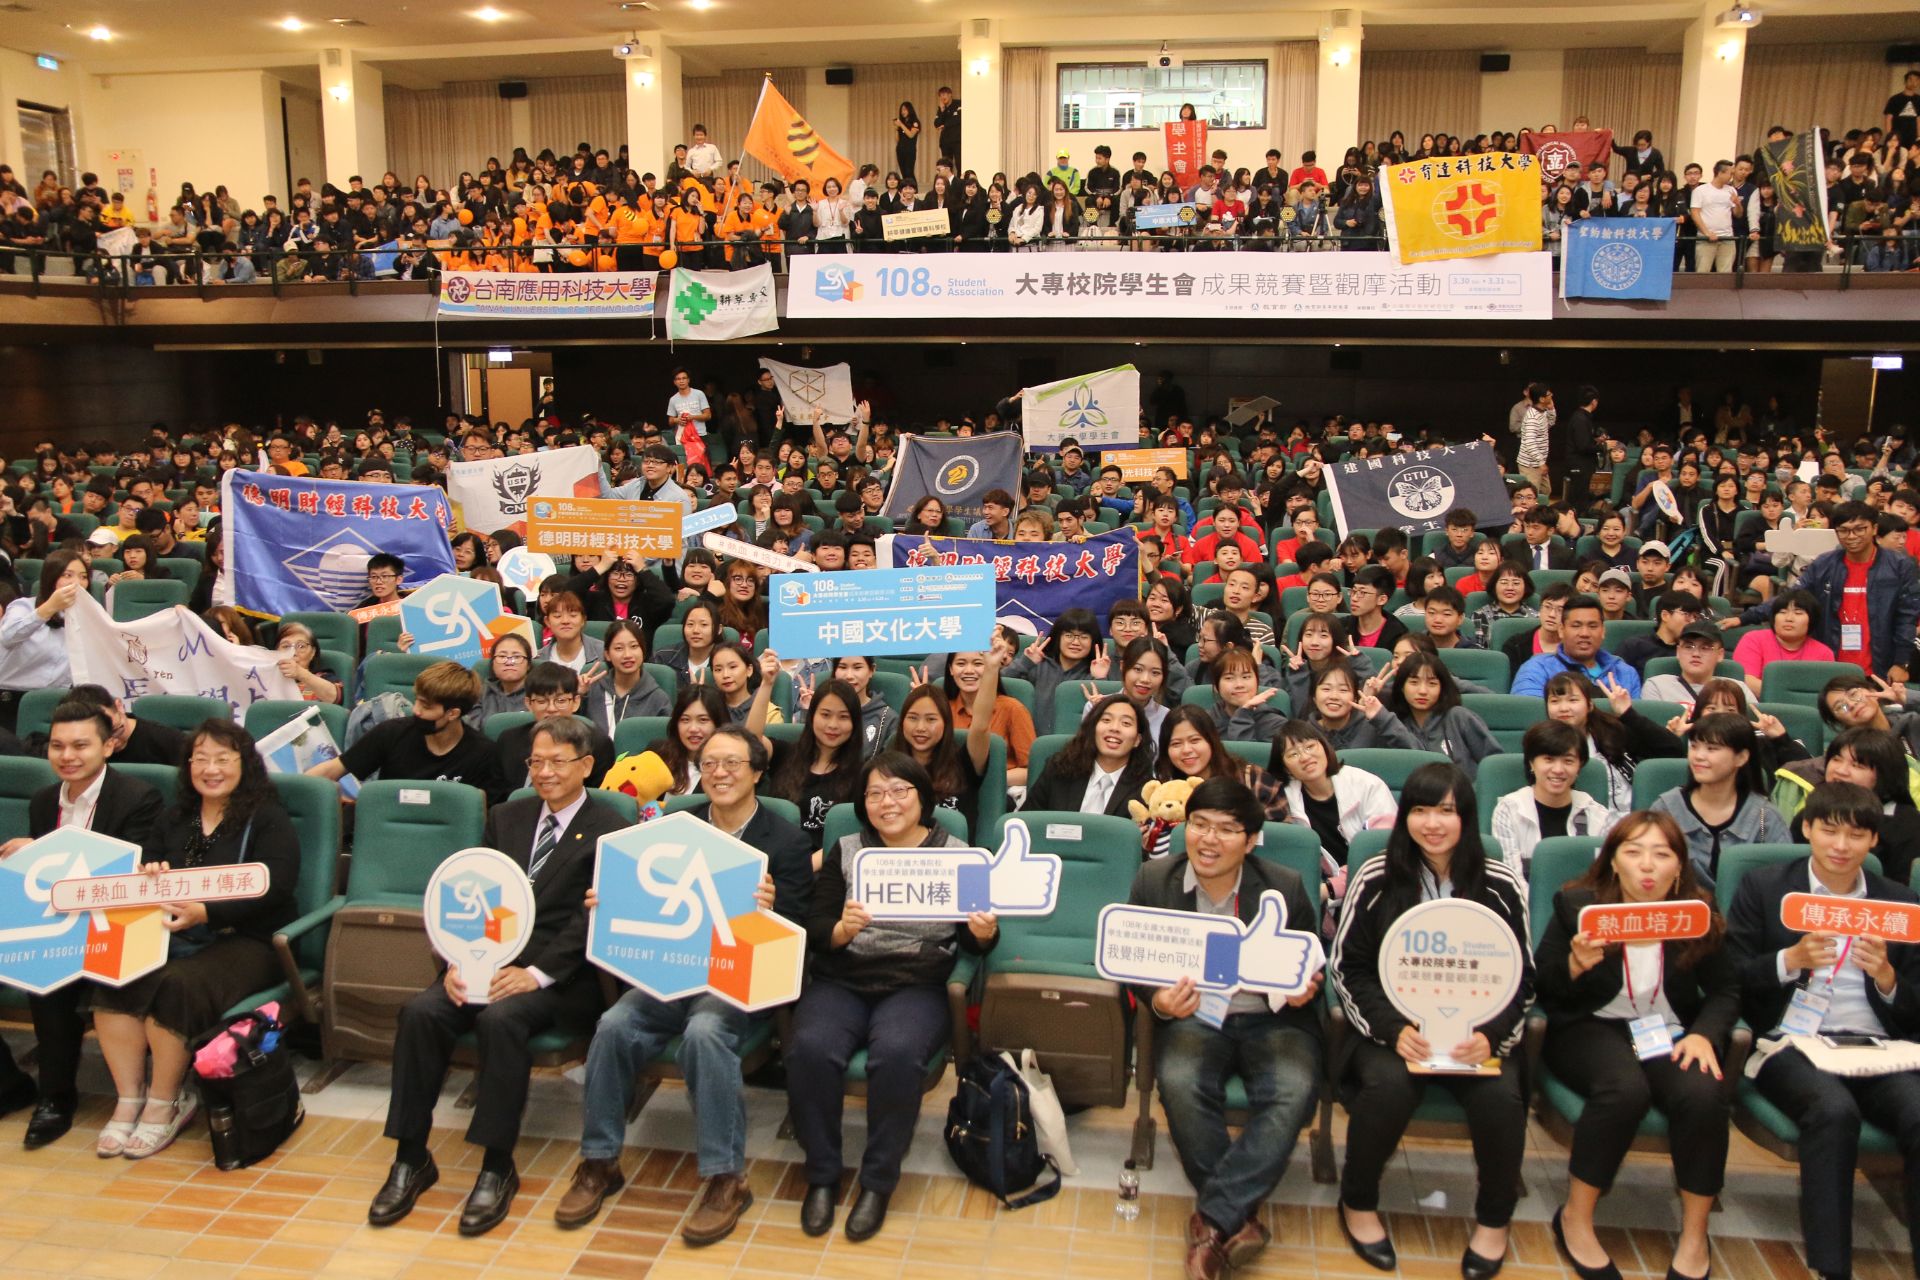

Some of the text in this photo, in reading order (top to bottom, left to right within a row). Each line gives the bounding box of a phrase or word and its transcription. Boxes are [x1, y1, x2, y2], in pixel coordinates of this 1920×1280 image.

[1419, 153, 1533, 181] 育達科技大學
[473, 277, 651, 302] 台南應用科技大學
[876, 266, 930, 297] 108
[947, 278, 987, 287] Student
[947, 287, 1004, 296] Association
[1015, 272, 1441, 297] 大專校院學生會 成果競賽暨觀摩活動
[1343, 439, 1480, 475] 建國科技大學
[507, 477, 528, 487] USP
[504, 501, 528, 515] CN
[537, 529, 674, 551] 德明財經科技大學
[818, 615, 962, 646] 中國文化大學
[91, 882, 129, 903] 熱血
[153, 876, 191, 898] 培力
[216, 872, 255, 894] 傳承
[865, 880, 952, 906] HEN棒
[1596, 910, 1693, 936] 熱血培力
[1799, 901, 1910, 936] 傳承永續
[42, 943, 109, 961] ASSOCIATION
[1401, 929, 1448, 954] 108
[1462, 940, 1496, 950] Student
[607, 945, 735, 971] STUDENT ASSOCIATION
[1106, 943, 1201, 969] 我覺得Hen可以
[1398, 956, 1480, 970] 大專校院學生會
